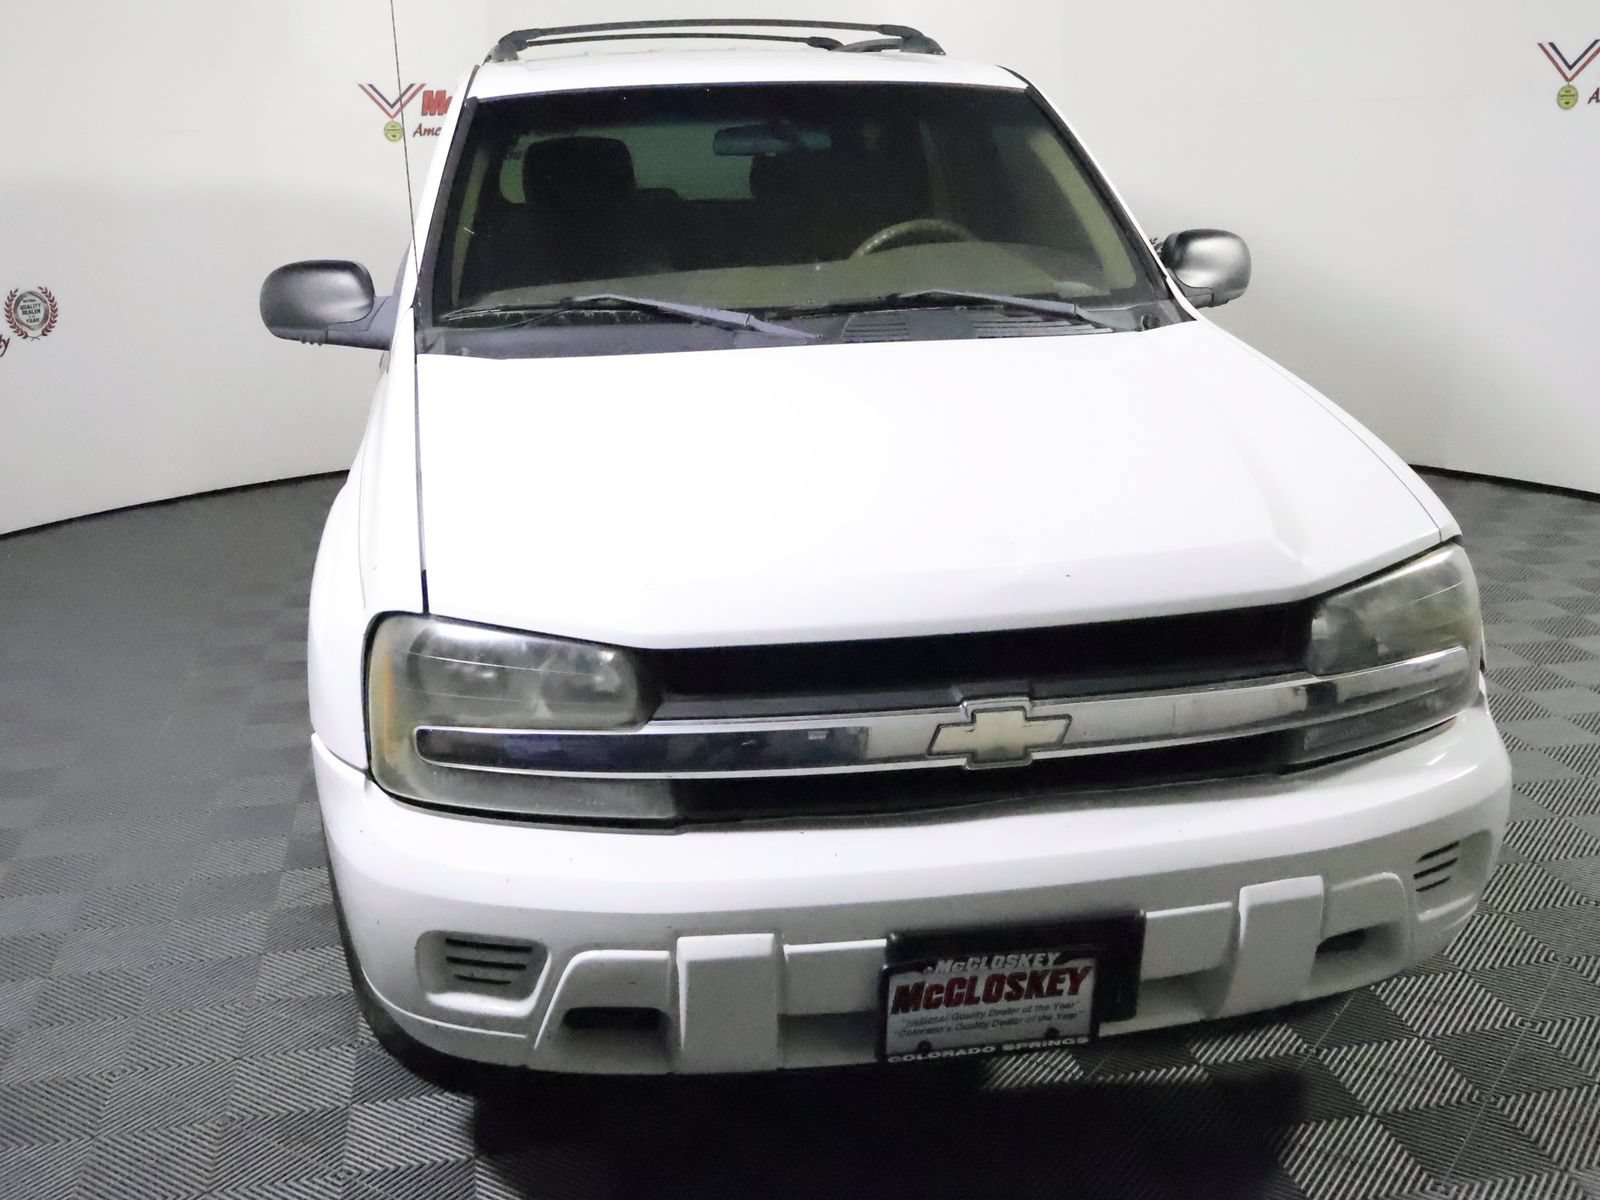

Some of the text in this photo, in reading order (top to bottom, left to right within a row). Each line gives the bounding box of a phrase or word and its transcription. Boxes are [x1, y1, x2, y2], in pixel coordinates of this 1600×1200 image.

[934, 952, 1061, 974] McCLOSKEY
[890, 966, 1093, 1015] McCLOSKEY
[951, 1010, 986, 1022] Quality
[988, 1006, 1019, 1018] Dealer
[1022, 1005, 1033, 1013] of
[1035, 1003, 1050, 1012] the
[954, 1020, 989, 1033] Quality
[991, 1016, 1023, 1028] Dealer
[1025, 1015, 1037, 1023] of
[1038, 1013, 1053, 1022] the
[887, 1036, 1089, 1063] COLORADO SPRINGS
